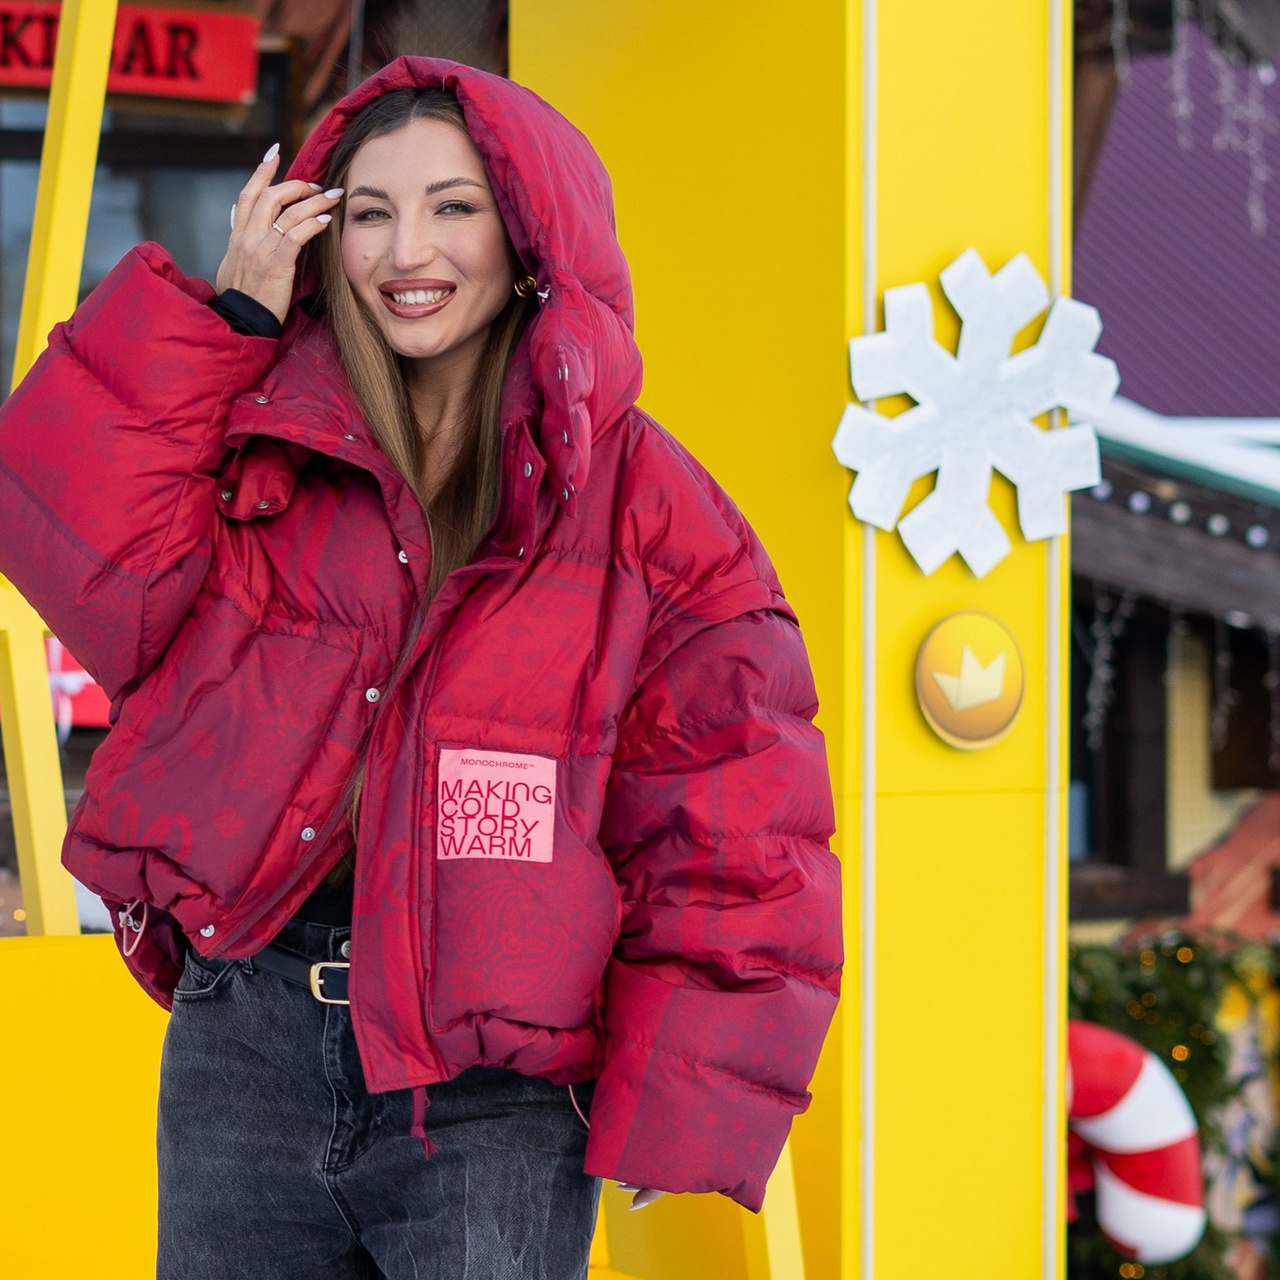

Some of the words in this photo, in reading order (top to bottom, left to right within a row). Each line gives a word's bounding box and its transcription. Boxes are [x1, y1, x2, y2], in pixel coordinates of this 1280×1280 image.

[111, 20, 200, 81] AR
[441, 797, 521, 819] COLD
[440, 816, 539, 838] STORY
[440, 834, 532, 858] WARM
